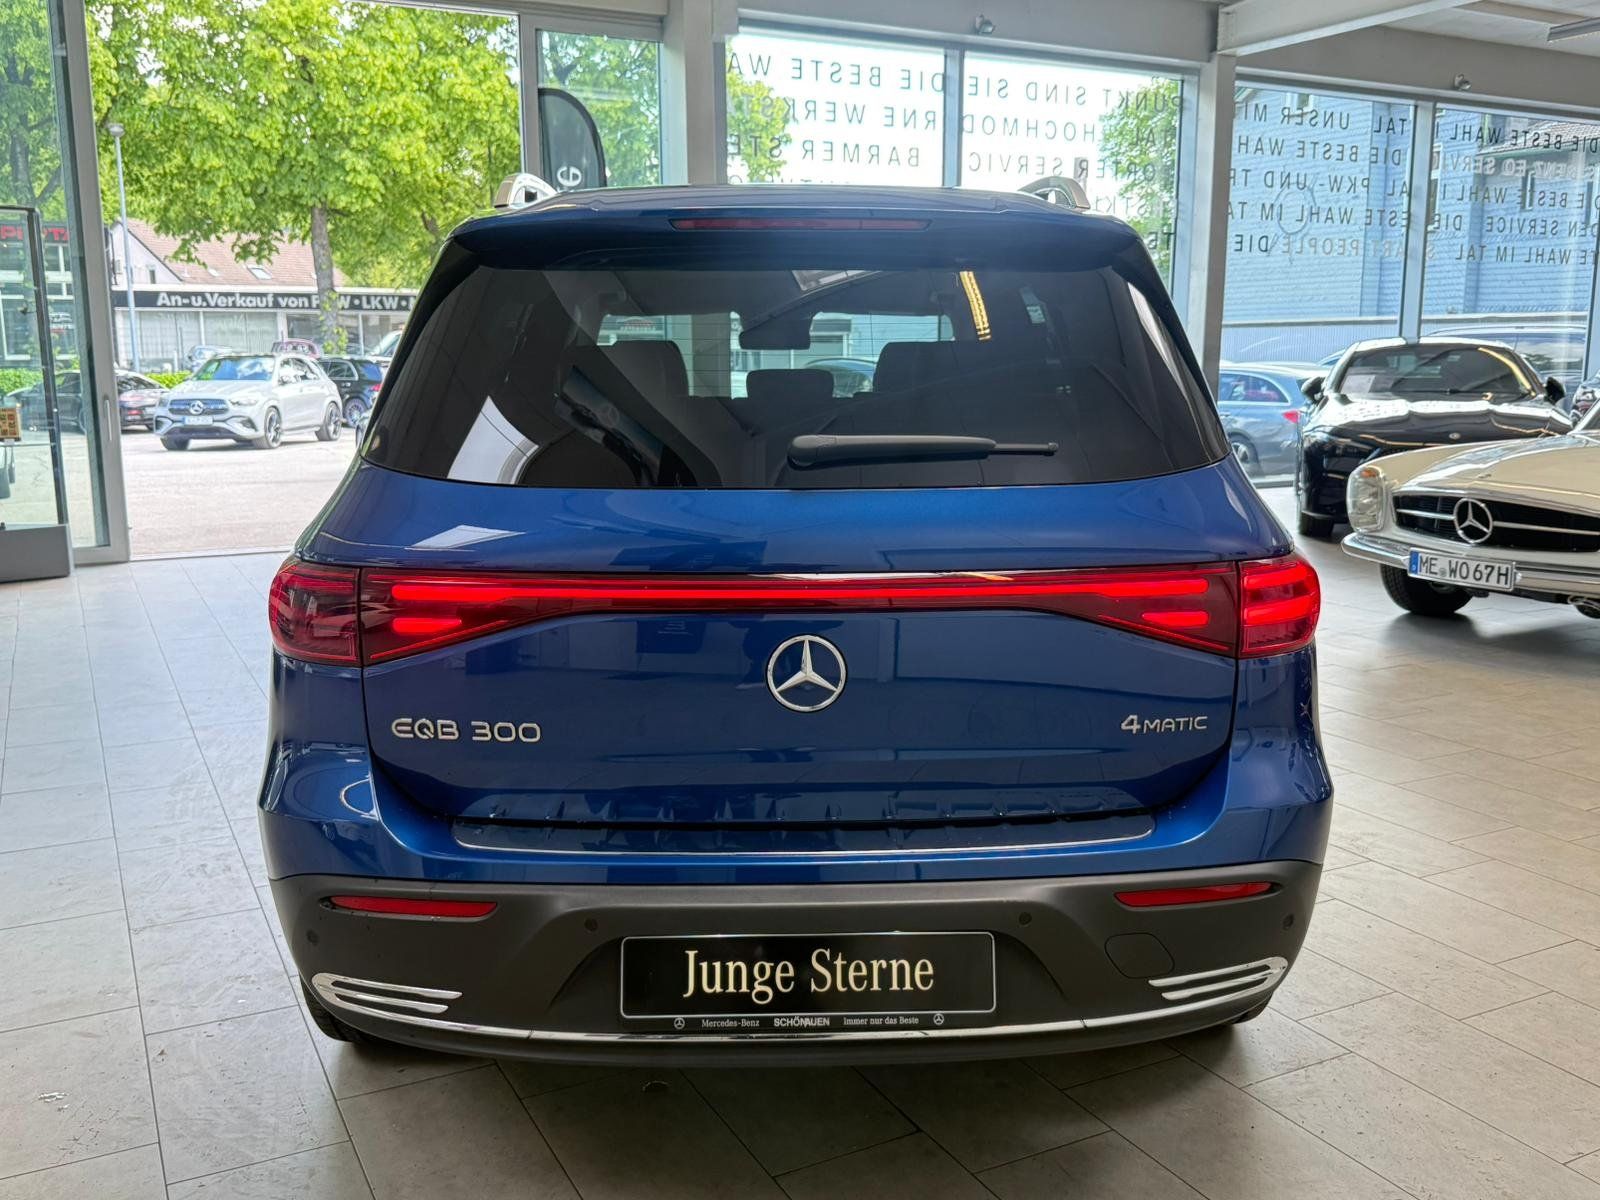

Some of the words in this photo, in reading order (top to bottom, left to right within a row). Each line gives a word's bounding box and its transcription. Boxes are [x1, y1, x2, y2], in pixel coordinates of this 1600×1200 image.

[278, 295, 310, 308] von
[361, 296, 399, 310] LKW
[1419, 554, 1438, 576] ME
[391, 717, 460, 741] EQB
[470, 720, 542, 743] 300
[1120, 714, 1208, 735] 4MATIC
[682, 949, 796, 1005] Junge
[809, 948, 935, 994] Sterne
[701, 1018, 760, 1029] Mercedes-Benz
[843, 1016, 869, 1026] Immer
[869, 1017, 884, 1026] nur
[884, 1015, 899, 1025] das
[899, 1015, 920, 1025] Beste
